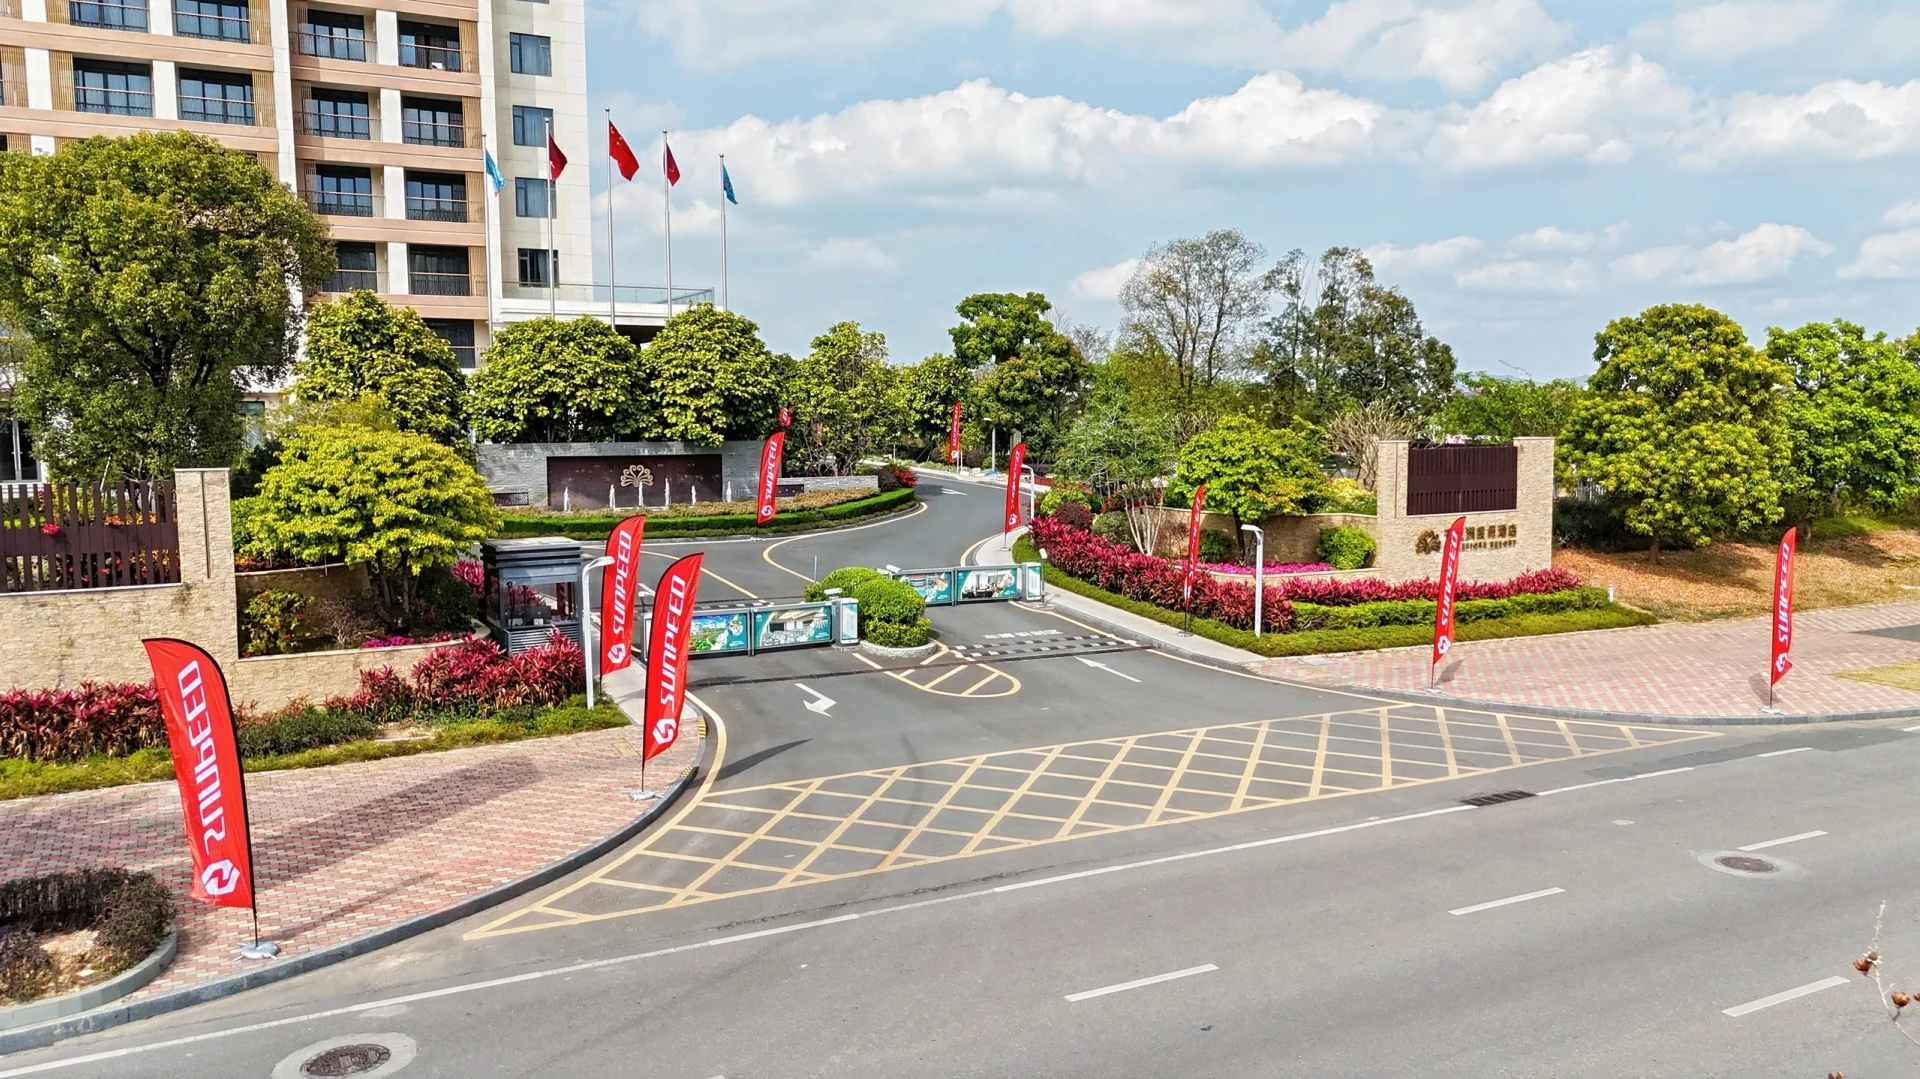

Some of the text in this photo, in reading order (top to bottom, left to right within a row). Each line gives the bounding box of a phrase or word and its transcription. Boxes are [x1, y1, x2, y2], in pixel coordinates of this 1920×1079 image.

[612, 530, 631, 640] SUNPEED
[1778, 542, 1789, 647] SUNPEED
[660, 575, 685, 712] SUNPEED
